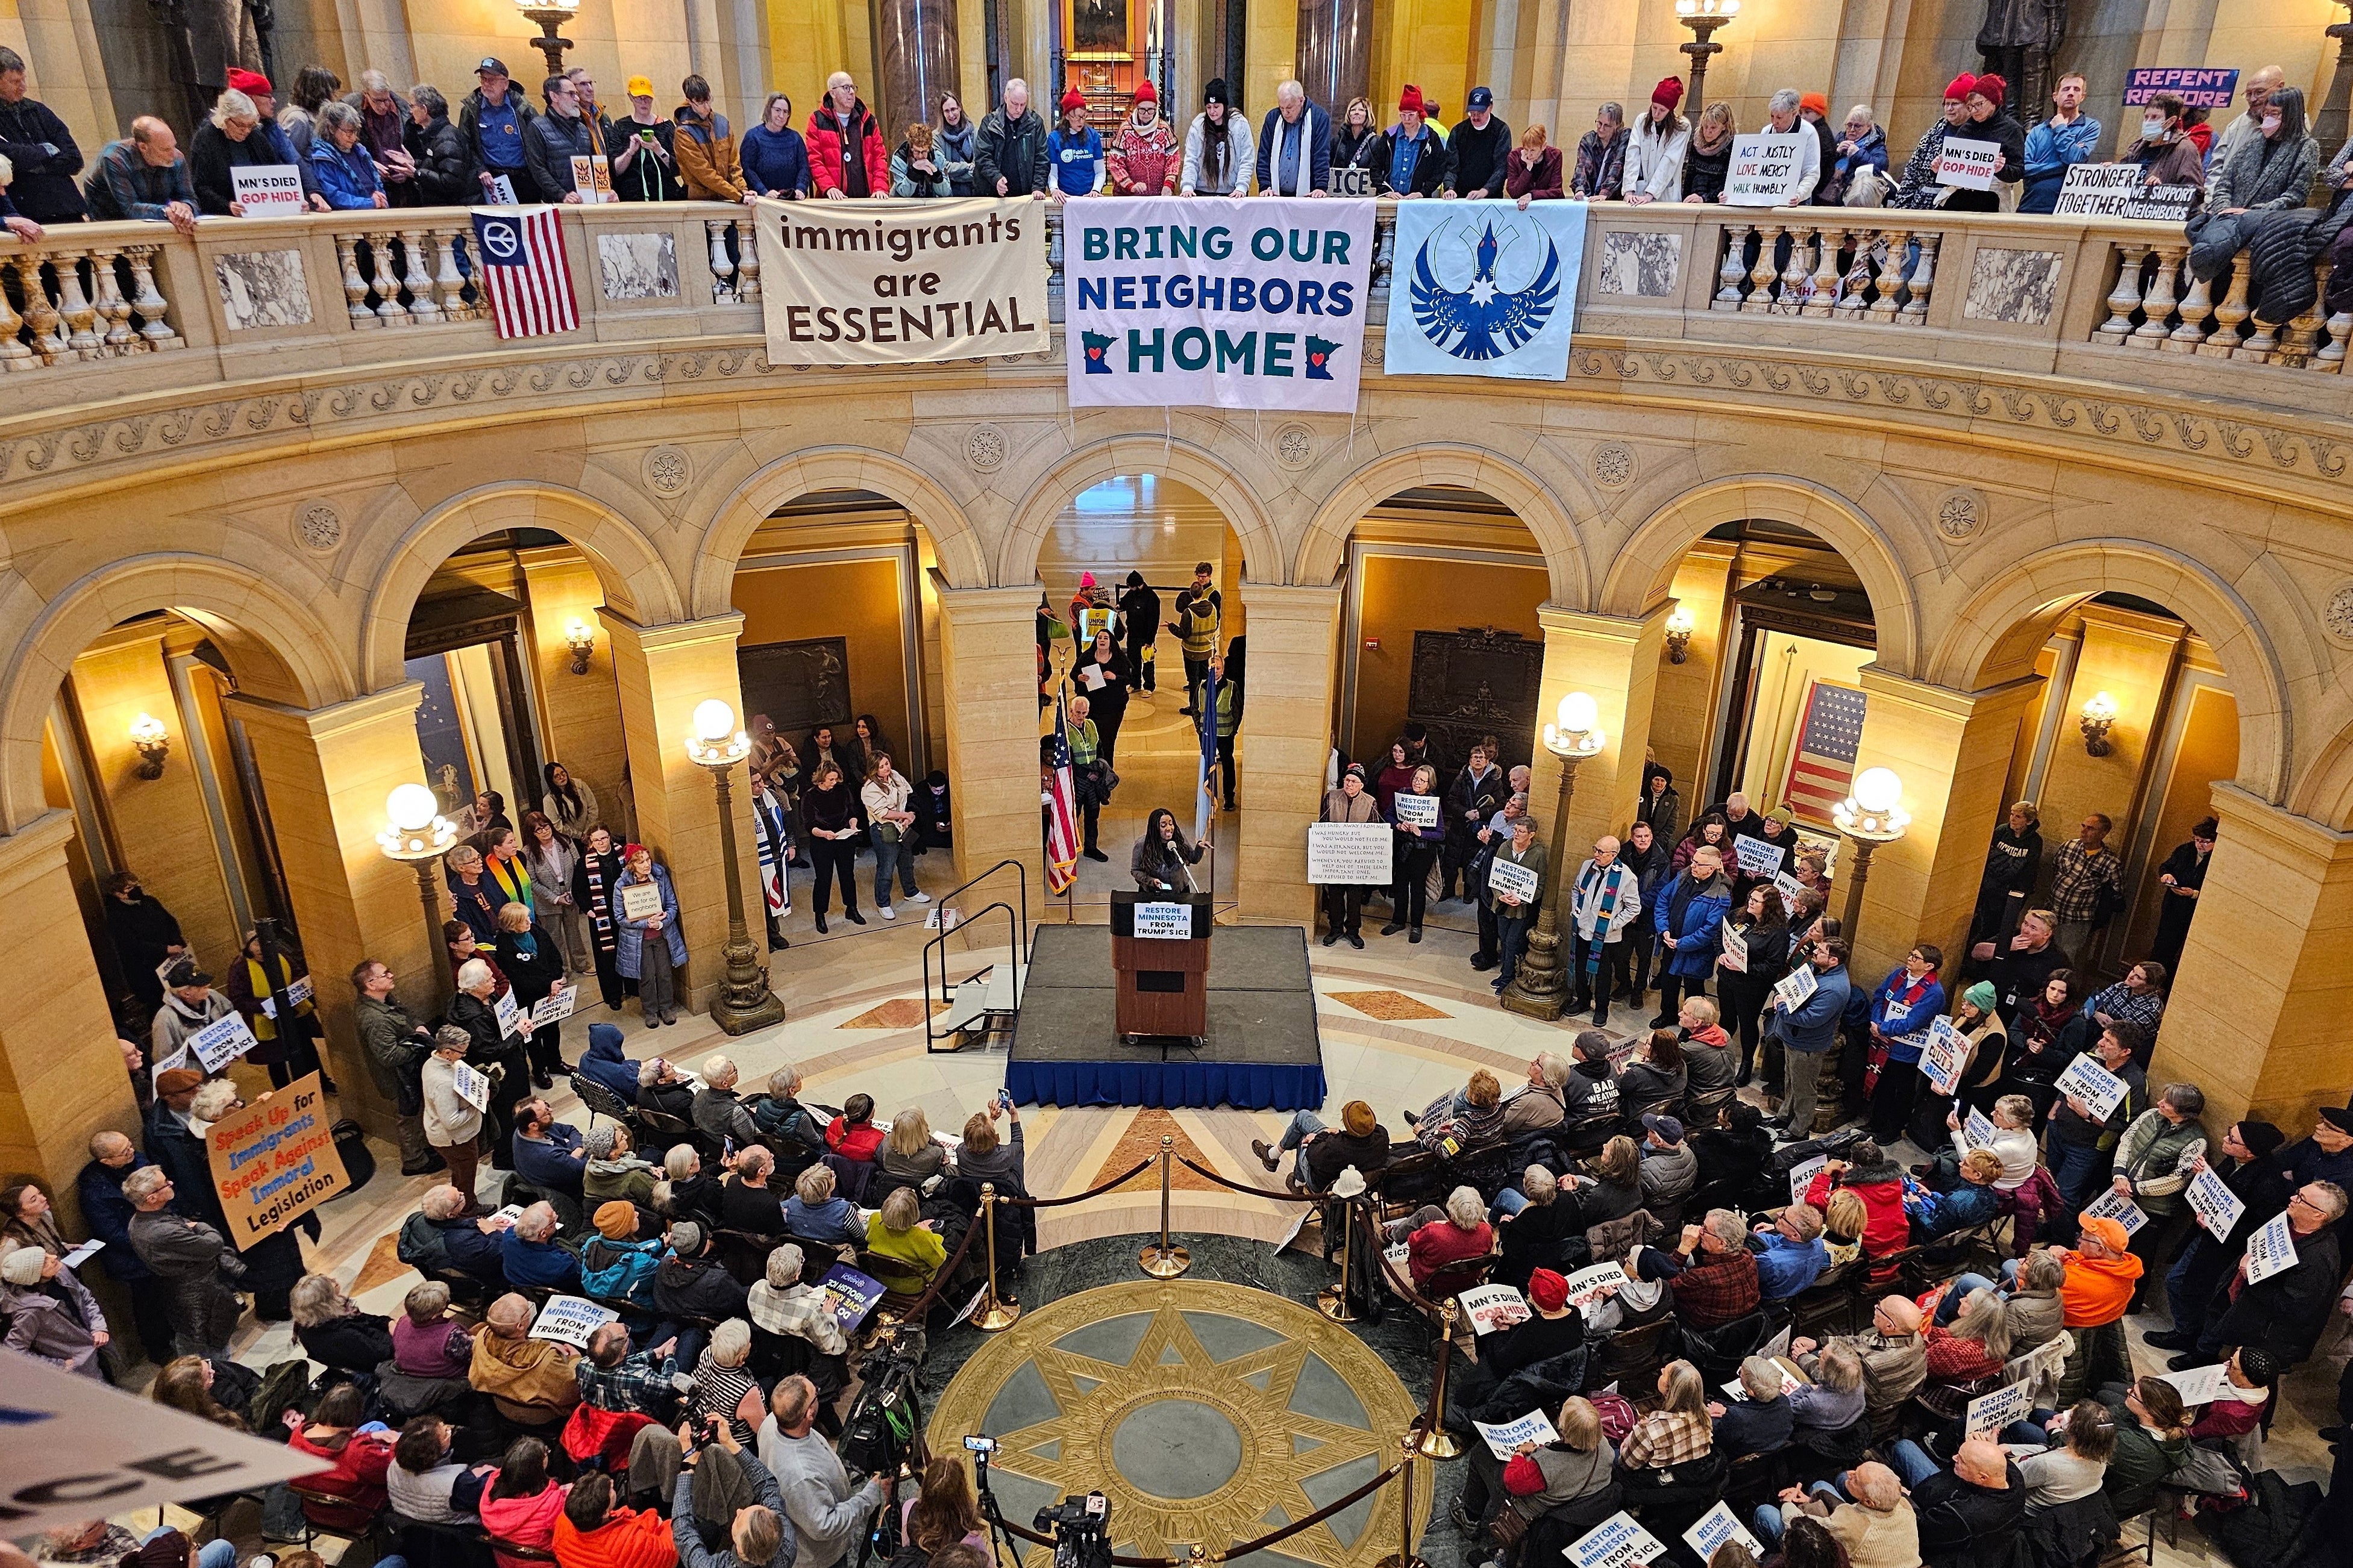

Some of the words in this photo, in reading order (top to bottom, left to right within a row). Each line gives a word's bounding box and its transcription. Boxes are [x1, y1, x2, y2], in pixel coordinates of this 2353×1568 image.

[2134, 70, 2231, 87] REPENT
[1740, 146, 1758, 157] ACT
[1762, 146, 1796, 158] JUSTLY
[1945, 148, 1970, 160] MN'S
[1972, 151, 1994, 163] DIED
[1737, 164, 1758, 175] LOVE
[1759, 164, 1791, 177] MERCY
[1943, 161, 1966, 172] GOP
[1966, 164, 1991, 178] HIDE
[2066, 166, 2135, 189] STRONGER
[237, 178, 269, 189] MN'S
[271, 177, 297, 187] DIED
[1333, 170, 1369, 195] ICE
[1733, 184, 1750, 193] WALK
[1752, 183, 1787, 194] HUMBLY
[241, 192, 269, 204] GOP
[271, 191, 300, 203] HIDE
[2131, 185, 2148, 199] WE
[2149, 186, 2196, 202] SUPPORT
[2057, 192, 2127, 216] TOGETHER
[2123, 202, 2189, 222] NEIGHBORS
[780, 212, 1020, 262] immigrants
[1083, 225, 1233, 261] BRING
[1251, 227, 1351, 265] OUR
[874, 272, 941, 298] are
[1077, 274, 1355, 317] NEIGHBORS
[786, 297, 1035, 343] ESSENTIAL
[1128, 326, 1296, 378] HOME
[1397, 802, 1435, 811] MINNESOTA
[1398, 813, 1423, 823] TRUMP'S
[1736, 843, 1779, 863] MINNESOTA
[1744, 839, 1775, 854] RESTORE
[1743, 853, 1765, 865] FROM
[1494, 867, 1534, 886] MINNESOTA
[1501, 863, 1531, 878] RESTORE
[1765, 867, 1775, 875] ICE
[1491, 878, 1520, 895] TRUMP'S
[1521, 891, 1532, 899] ICE
[1503, 876, 1523, 888] FROM
[1778, 879, 1796, 894] MN'S
[631, 904, 657, 913] neighbors
[536, 996, 572, 1014] MINNESOTA
[542, 1006, 560, 1017] FROM
[1891, 1004, 1905, 1016] ICE
[533, 1013, 560, 1026] TRUMP'S
[1934, 1020, 1952, 1038] GOD
[198, 1019, 233, 1043] RESTORE
[198, 1023, 243, 1054] MINNESOTA
[206, 1045, 239, 1069] TRUMP'S
[239, 1036, 254, 1049] ICE
[212, 1037, 234, 1055] FROM
[1622, 1039, 1638, 1049] DIED
[2071, 1064, 2118, 1102] MINNESOTA
[2082, 1061, 2118, 1090] RESTORE
[1591, 1079, 1615, 1094] BAD
[2075, 1079, 2101, 1099] FROM
[1587, 1089, 1620, 1104] WEATHER
[2060, 1078, 2095, 1109] TRUMP'S
[2094, 1103, 2109, 1117] ICE
[215, 1114, 264, 1151] Speak
[268, 1106, 289, 1125] Up
[293, 1091, 316, 1112] for
[1426, 1111, 1443, 1126] FROM
[1441, 1113, 1452, 1123] ICE
[1972, 1113, 1991, 1134] RESTORE
[229, 1114, 315, 1171] Immigrants
[221, 1160, 269, 1199] Speak
[274, 1128, 331, 1170] Against
[250, 1155, 316, 1205] Immoral
[1793, 1172, 1808, 1186] MN'S
[2198, 1174, 2234, 1222] MINNESOTA
[2205, 1172, 2234, 1207] RESTORE
[246, 1173, 335, 1232] Legislation
[2103, 1202, 2123, 1219] FROM
[2201, 1192, 2220, 1217] FROM
[2189, 1188, 2214, 1224] TRUMP'S
[2213, 1222, 2226, 1237] ICE
[2259, 1237, 2268, 1261] FROM
[2266, 1223, 2281, 1269] MINNESOTA
[2275, 1222, 2289, 1258] RESTORE
[2251, 1266, 2262, 1280] ICE
[1568, 1278, 1597, 1296] MN'S
[1597, 1271, 1622, 1284] DIED
[837, 1284, 866, 1303] ABOLISH
[1468, 1294, 1500, 1310] MN'S
[1500, 1293, 1521, 1303] DIED
[547, 1307, 604, 1326] MINNESOT
[559, 1300, 605, 1319] RESTORE
[1503, 1305, 1529, 1316] HIDE
[536, 1325, 580, 1340] TRUMP'S
[555, 1318, 587, 1331] FROM
[1971, 1392, 2023, 1421] MINNESOTA
[1979, 1386, 2019, 1409] RESTORE
[1983, 1407, 2008, 1425] FROM
[2007, 1408, 2022, 1420] ICE
[1486, 1423, 1547, 1445] MINNESOTA
[1487, 1419, 1534, 1435] RESTORE
[1697, 1512, 1726, 1540] RESTORE
[1578, 1522, 1623, 1555] RESTORE
[1580, 1525, 1640, 1567] MINNESOTA
[1700, 1519, 1740, 1556] MINNESOTA
[1602, 1543, 1634, 1567] FROM
[1640, 1541, 1659, 1555] ICE
